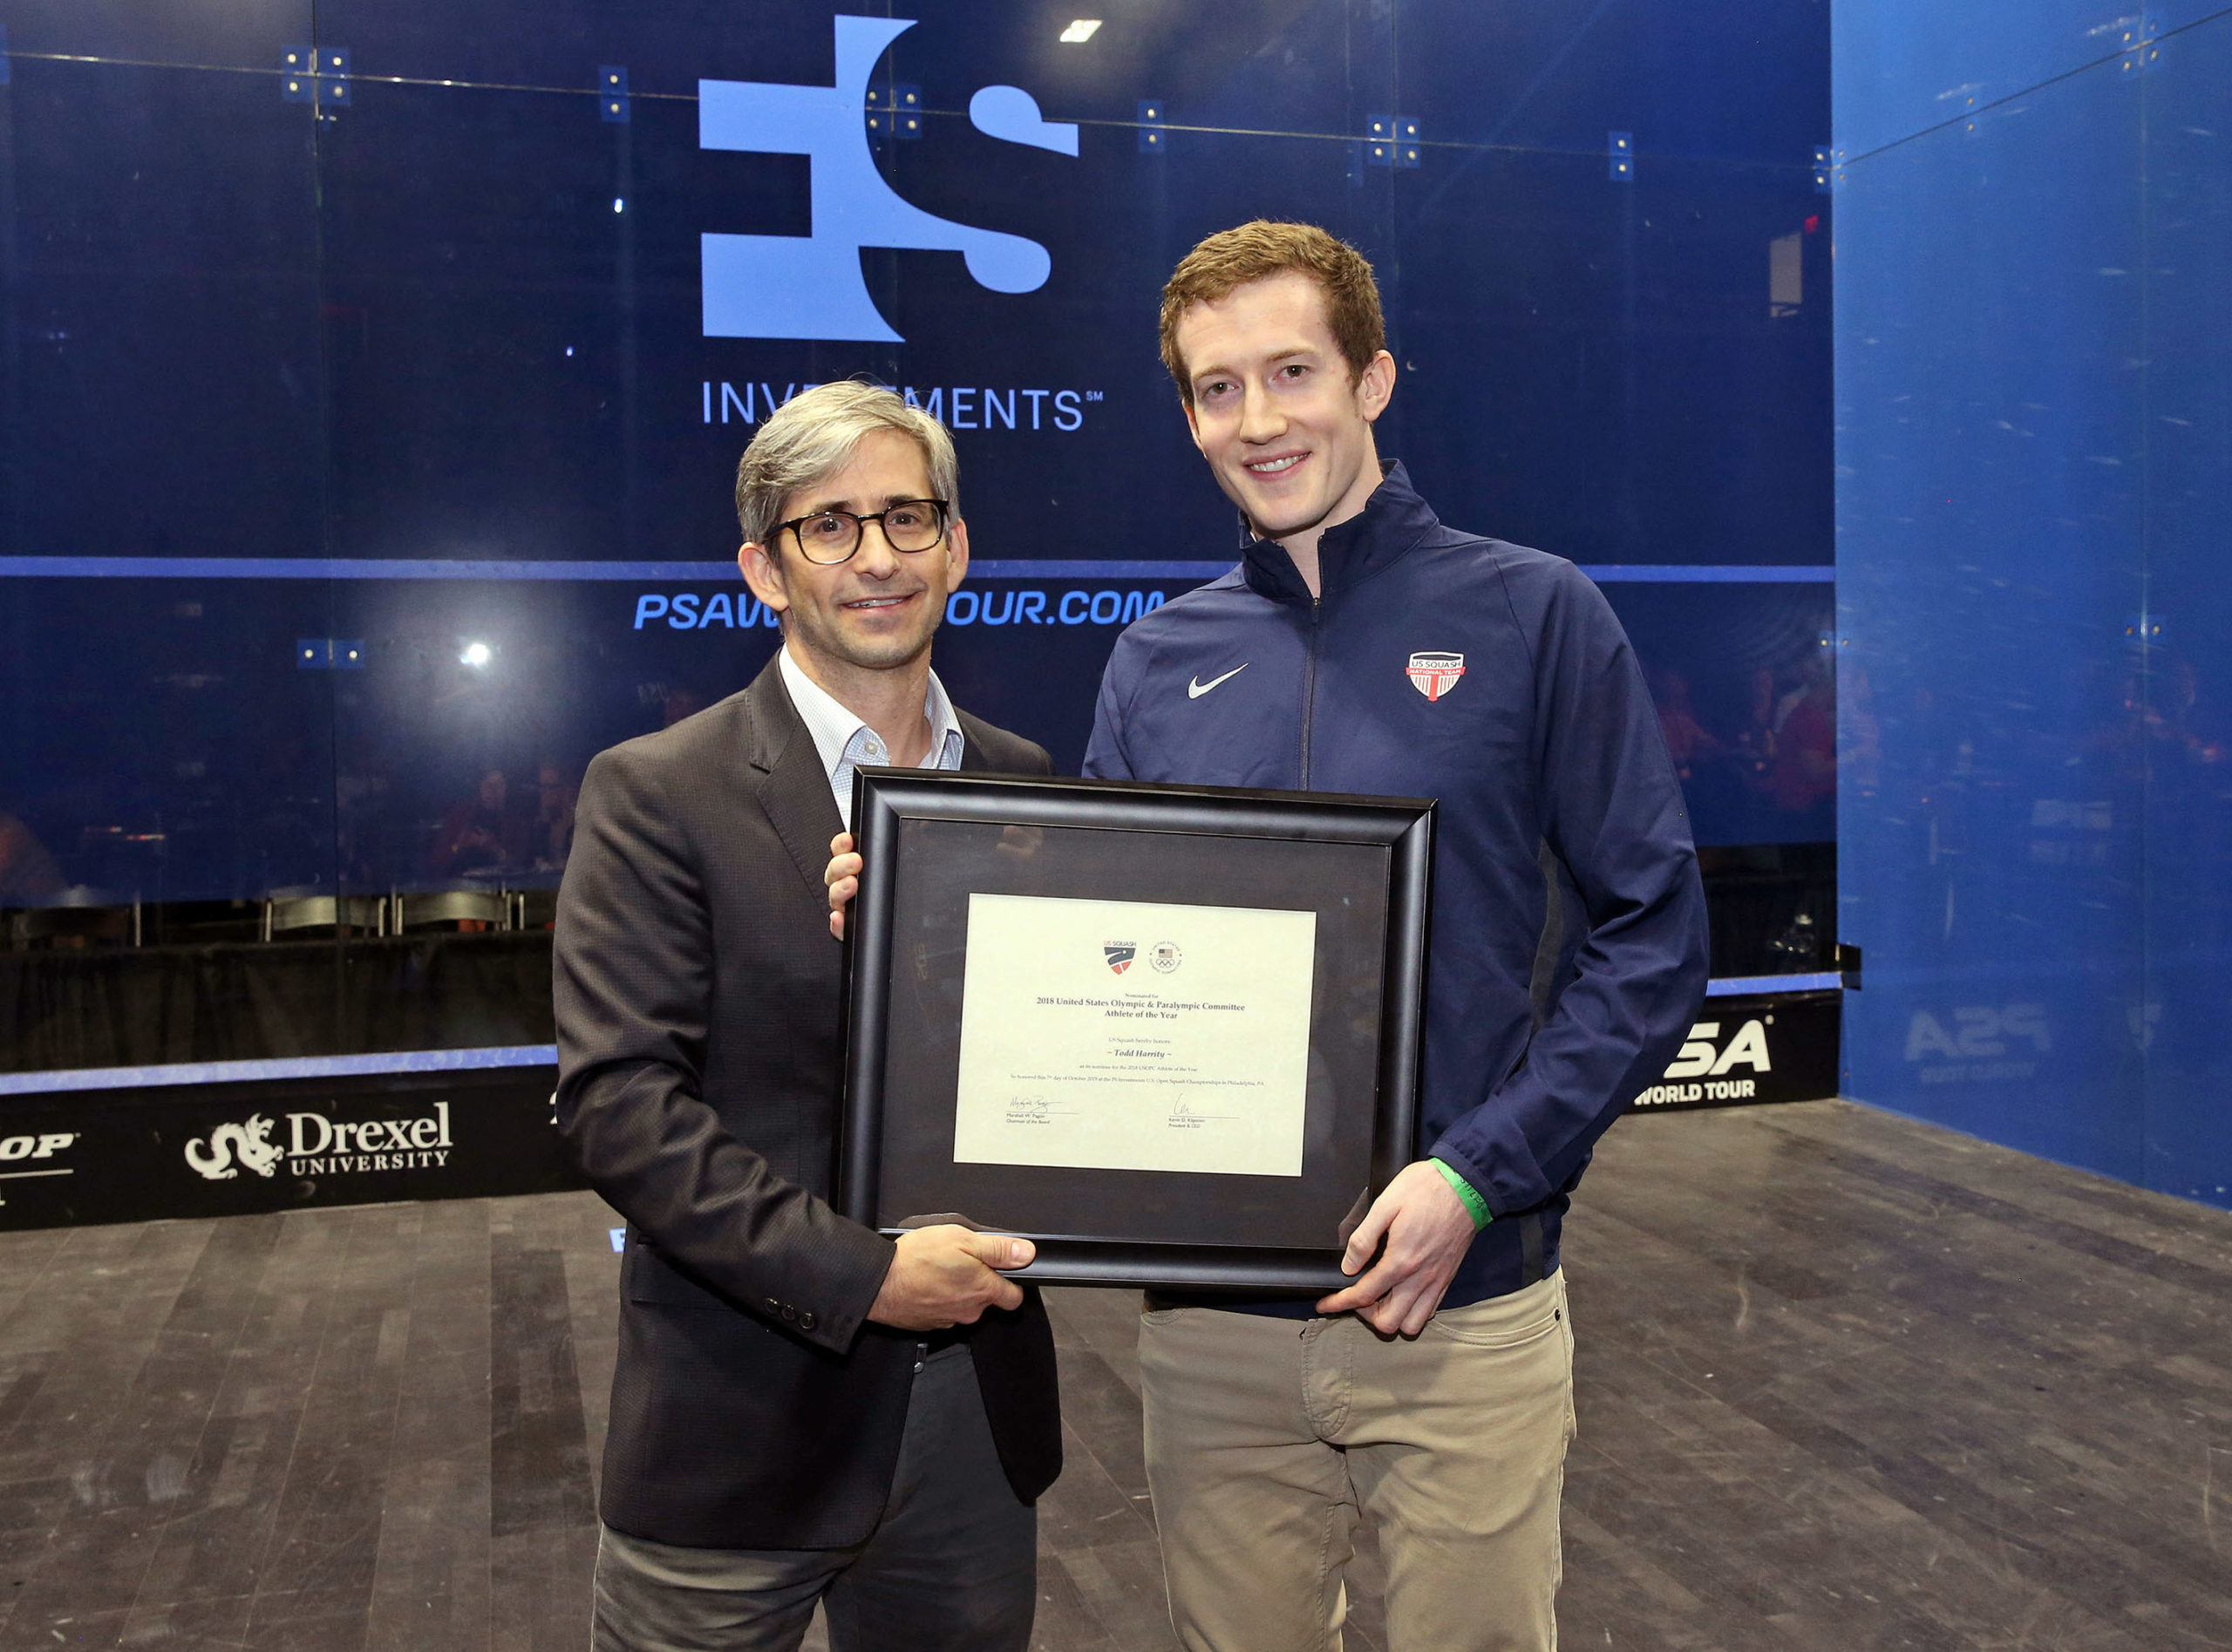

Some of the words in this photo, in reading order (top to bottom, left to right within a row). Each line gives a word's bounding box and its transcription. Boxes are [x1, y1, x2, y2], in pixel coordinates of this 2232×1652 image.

[703, 380, 1084, 432] INVMENTS
[634, 590, 1166, 630] PSAWOUR.COM
[1037, 996, 1054, 1005] 2018
[1056, 997, 1084, 1006] United
[1085, 998, 1109, 1007] States
[1110, 999, 1145, 1010] Olympic
[1147, 1000, 1154, 1009] &
[1156, 1001, 1200, 1011] Paralympic
[1201, 1003, 1246, 1011] Committee
[1105, 1010, 1133, 1018] Athlete
[1114, 1049, 1134, 1057] Todd
[1136, 1050, 1166, 1061] Harrity
[1663, 1019, 1772, 1079] SA
[1634, 1083, 1703, 1106] WORLD
[1704, 1079, 1756, 1101] TOUR
[286, 1100, 453, 1157] Drexel
[289, 1149, 451, 1177] UNIVERSITY
